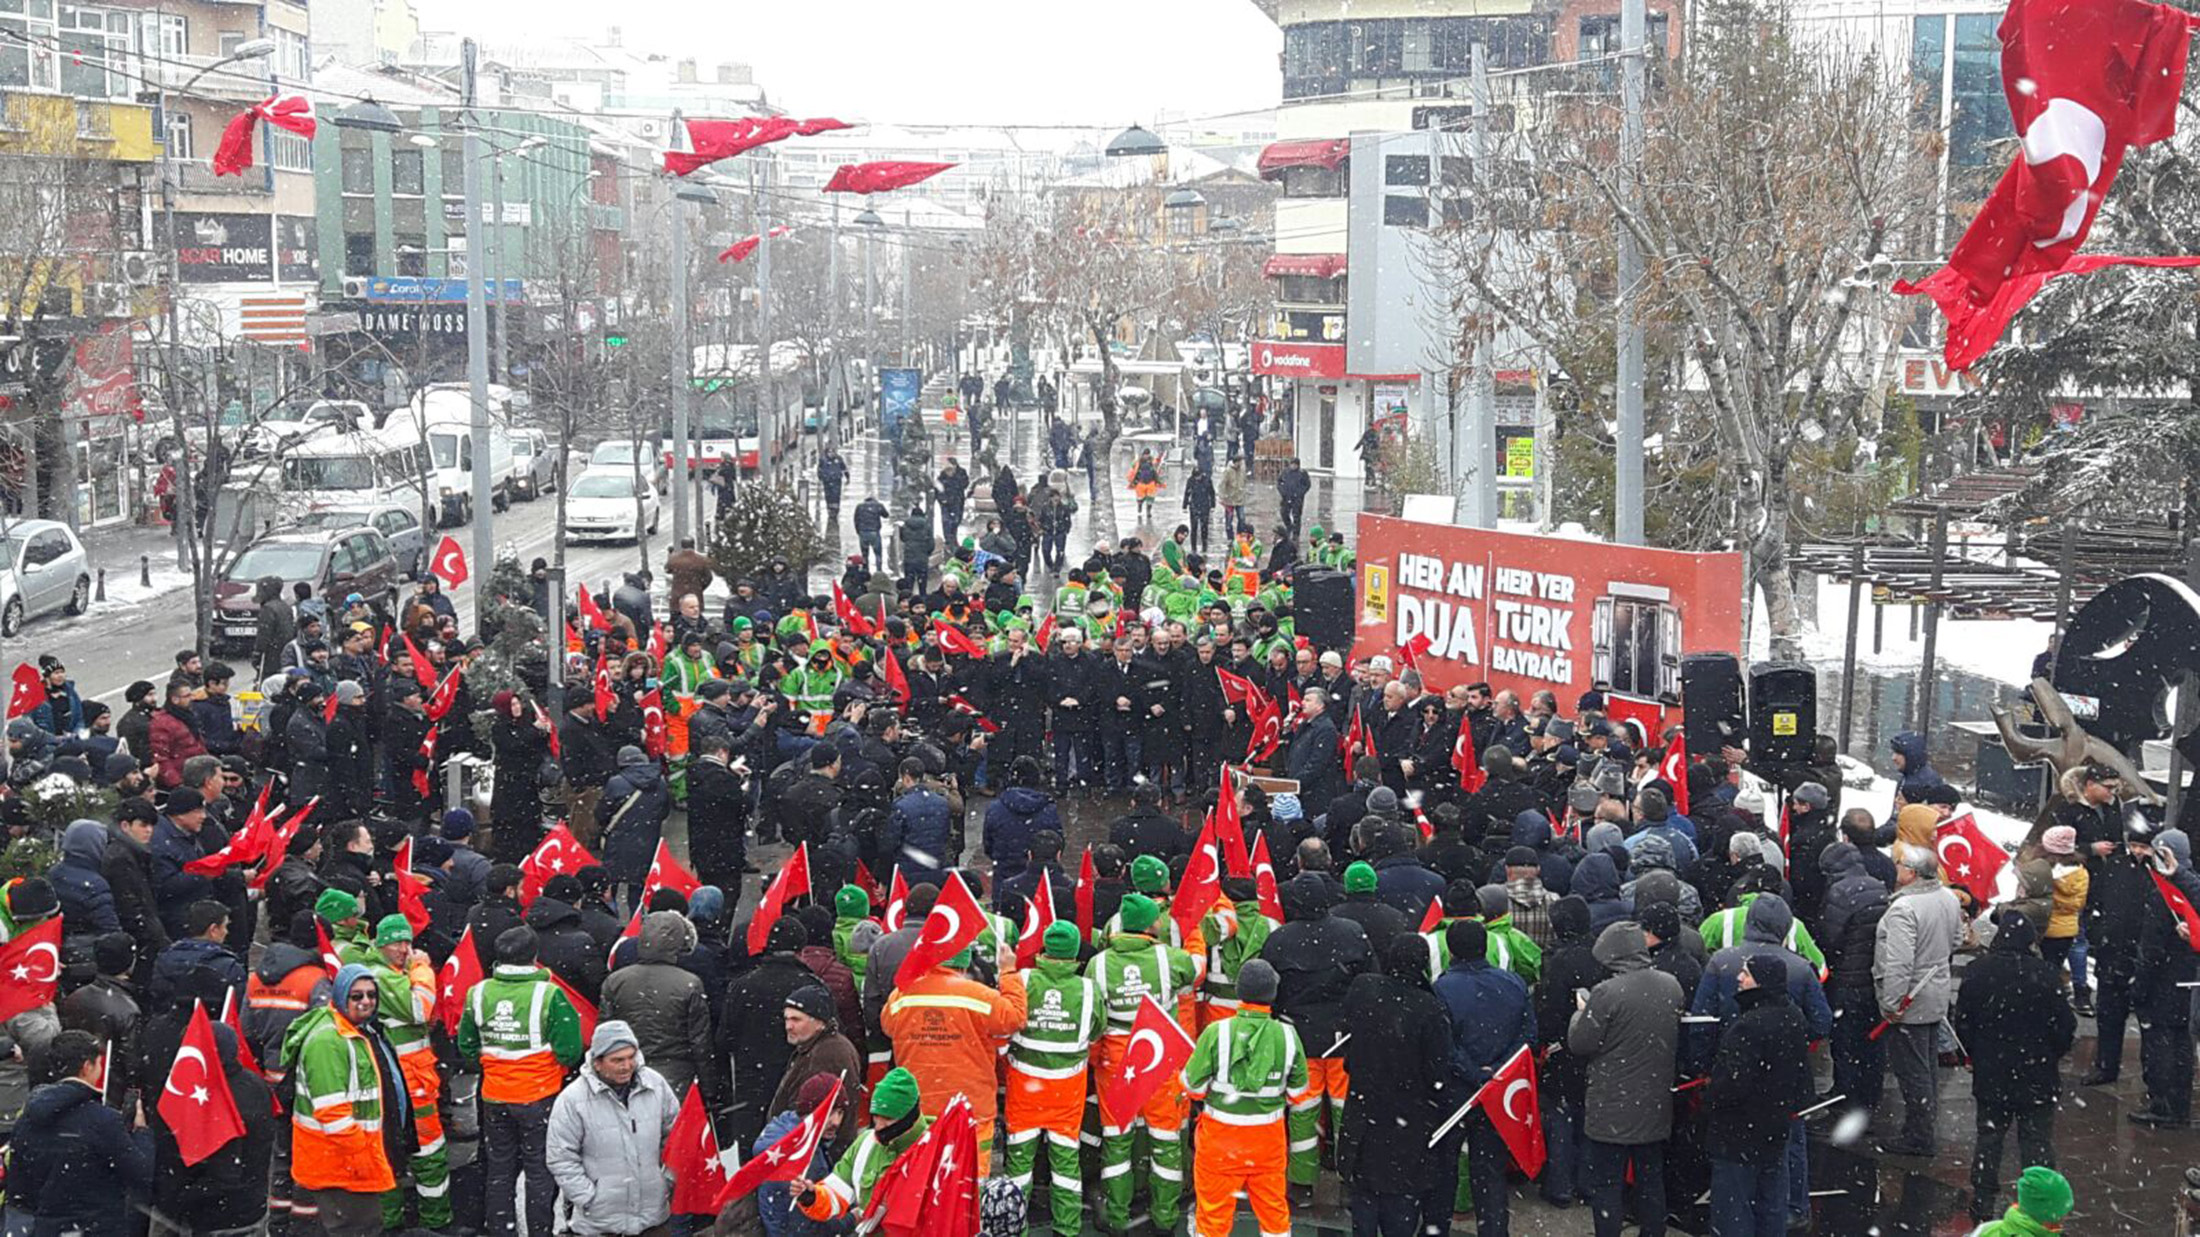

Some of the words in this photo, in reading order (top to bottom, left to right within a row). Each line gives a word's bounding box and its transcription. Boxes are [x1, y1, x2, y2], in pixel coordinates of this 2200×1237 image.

[223, 248, 268, 264] HOME
[390, 283, 420, 294] Coral
[365, 312, 410, 331] DAME
[1273, 353, 1310, 367] vodafone
[1398, 552, 1443, 593] HER
[1447, 561, 1485, 600] AN
[1495, 566, 1534, 597] HER
[1537, 572, 1575, 603] YER
[1396, 593, 1480, 665] DUA
[1495, 599, 1574, 650] TÜRK
[1492, 645, 1573, 684] BAYRAĞI
